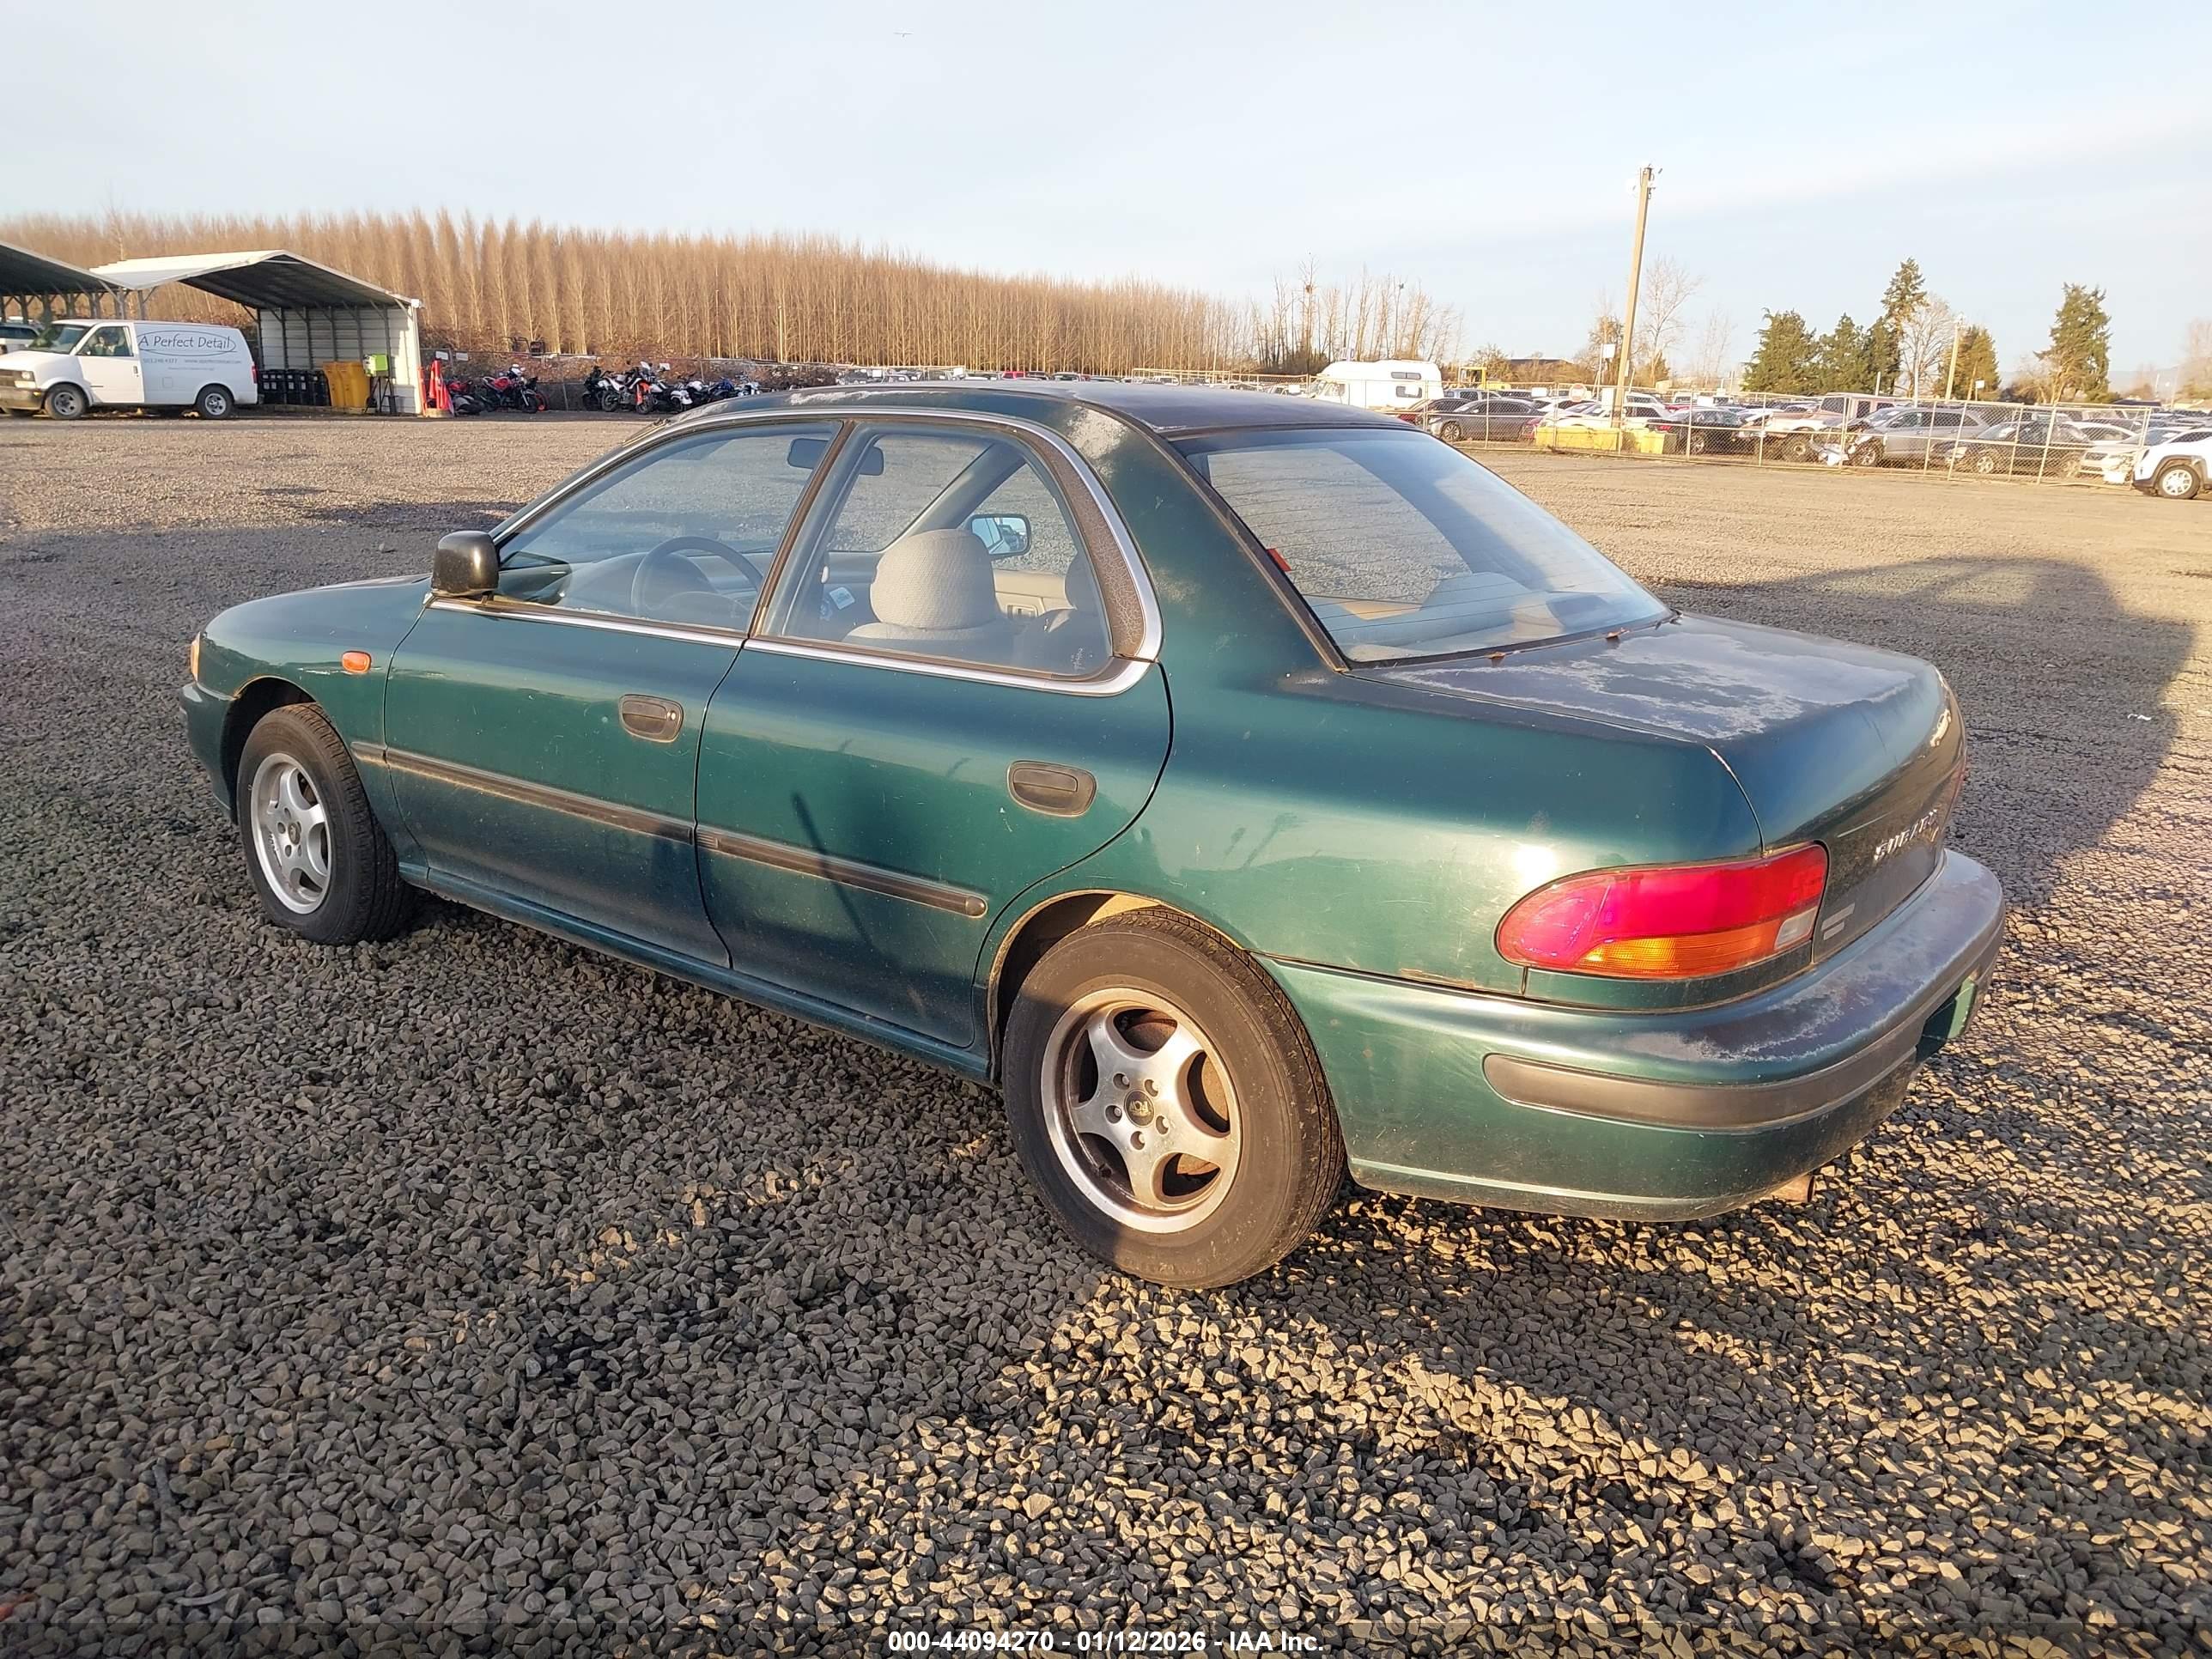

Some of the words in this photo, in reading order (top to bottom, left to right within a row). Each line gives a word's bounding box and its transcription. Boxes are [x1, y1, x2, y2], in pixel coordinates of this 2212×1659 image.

[139, 335, 149, 346] A
[154, 333, 194, 347] Perfect
[198, 336, 230, 349] Detail
